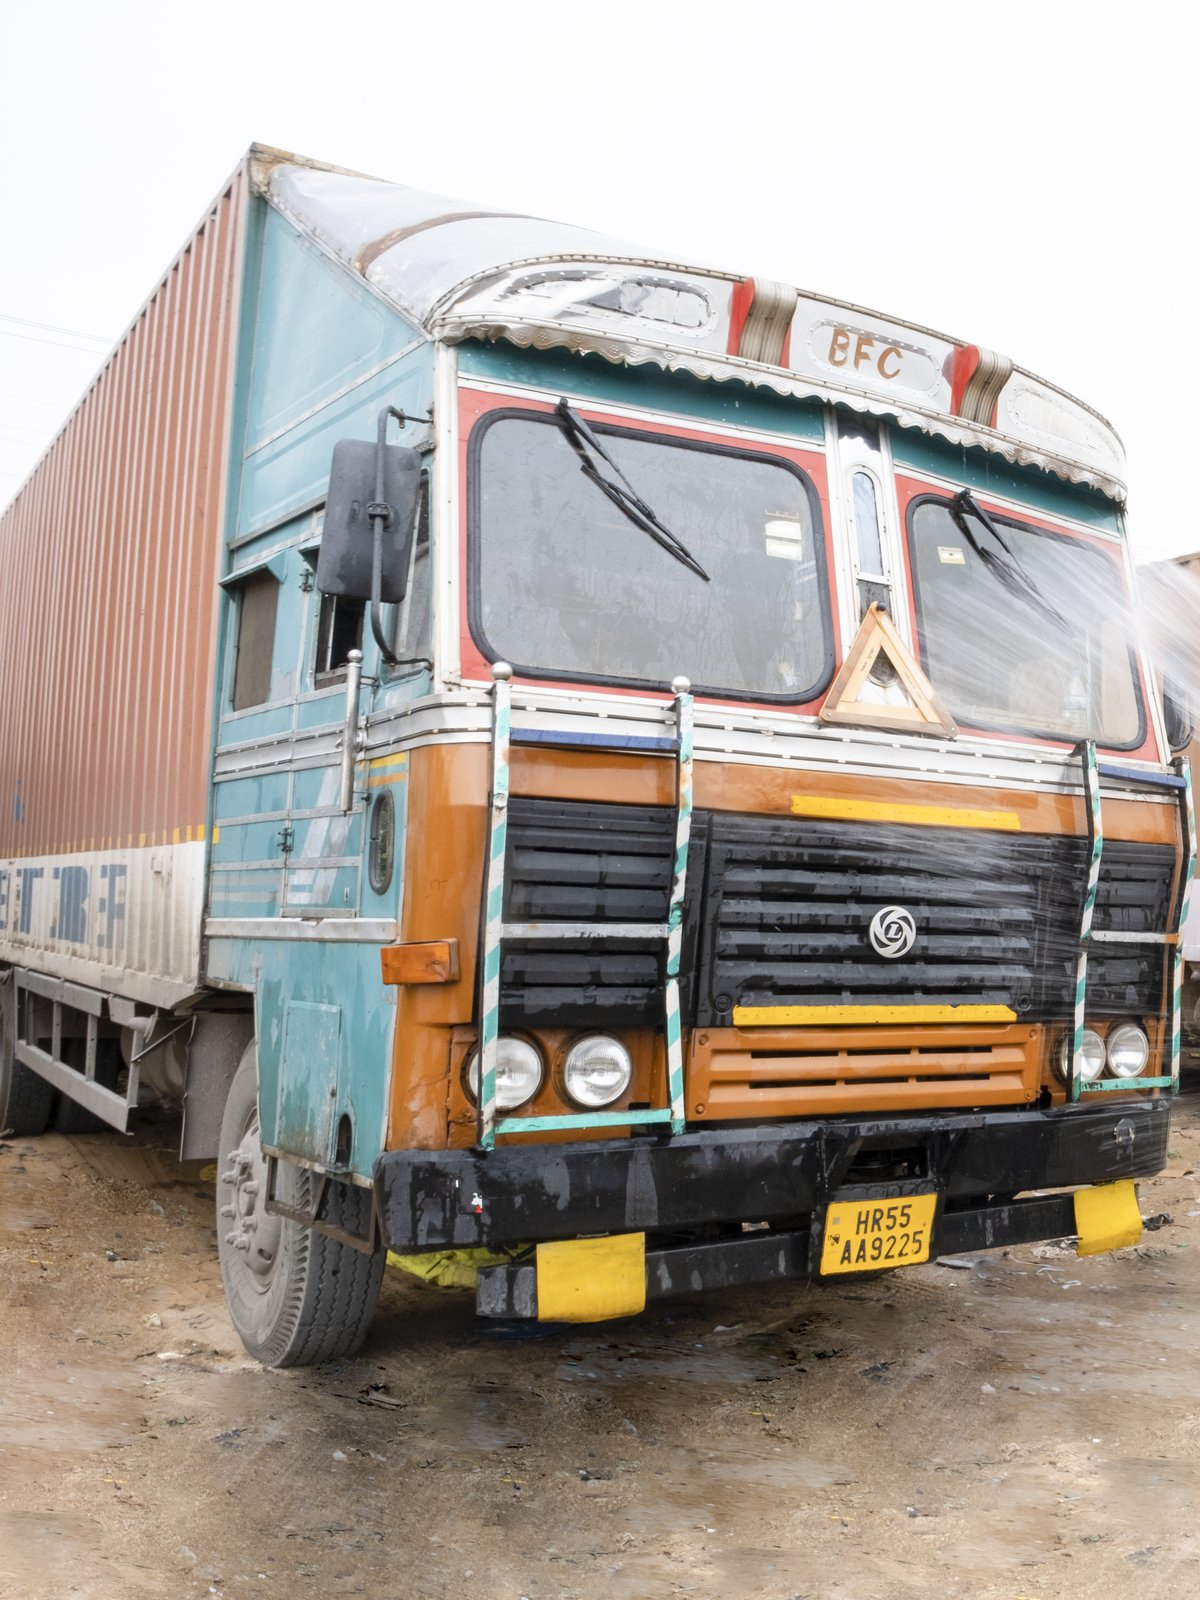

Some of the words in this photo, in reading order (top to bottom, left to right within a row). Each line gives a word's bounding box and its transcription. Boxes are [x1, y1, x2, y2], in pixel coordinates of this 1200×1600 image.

[828, 327, 903, 379] BFC
[855, 1204, 912, 1235] HR55
[840, 1230, 923, 1265] AA9225
